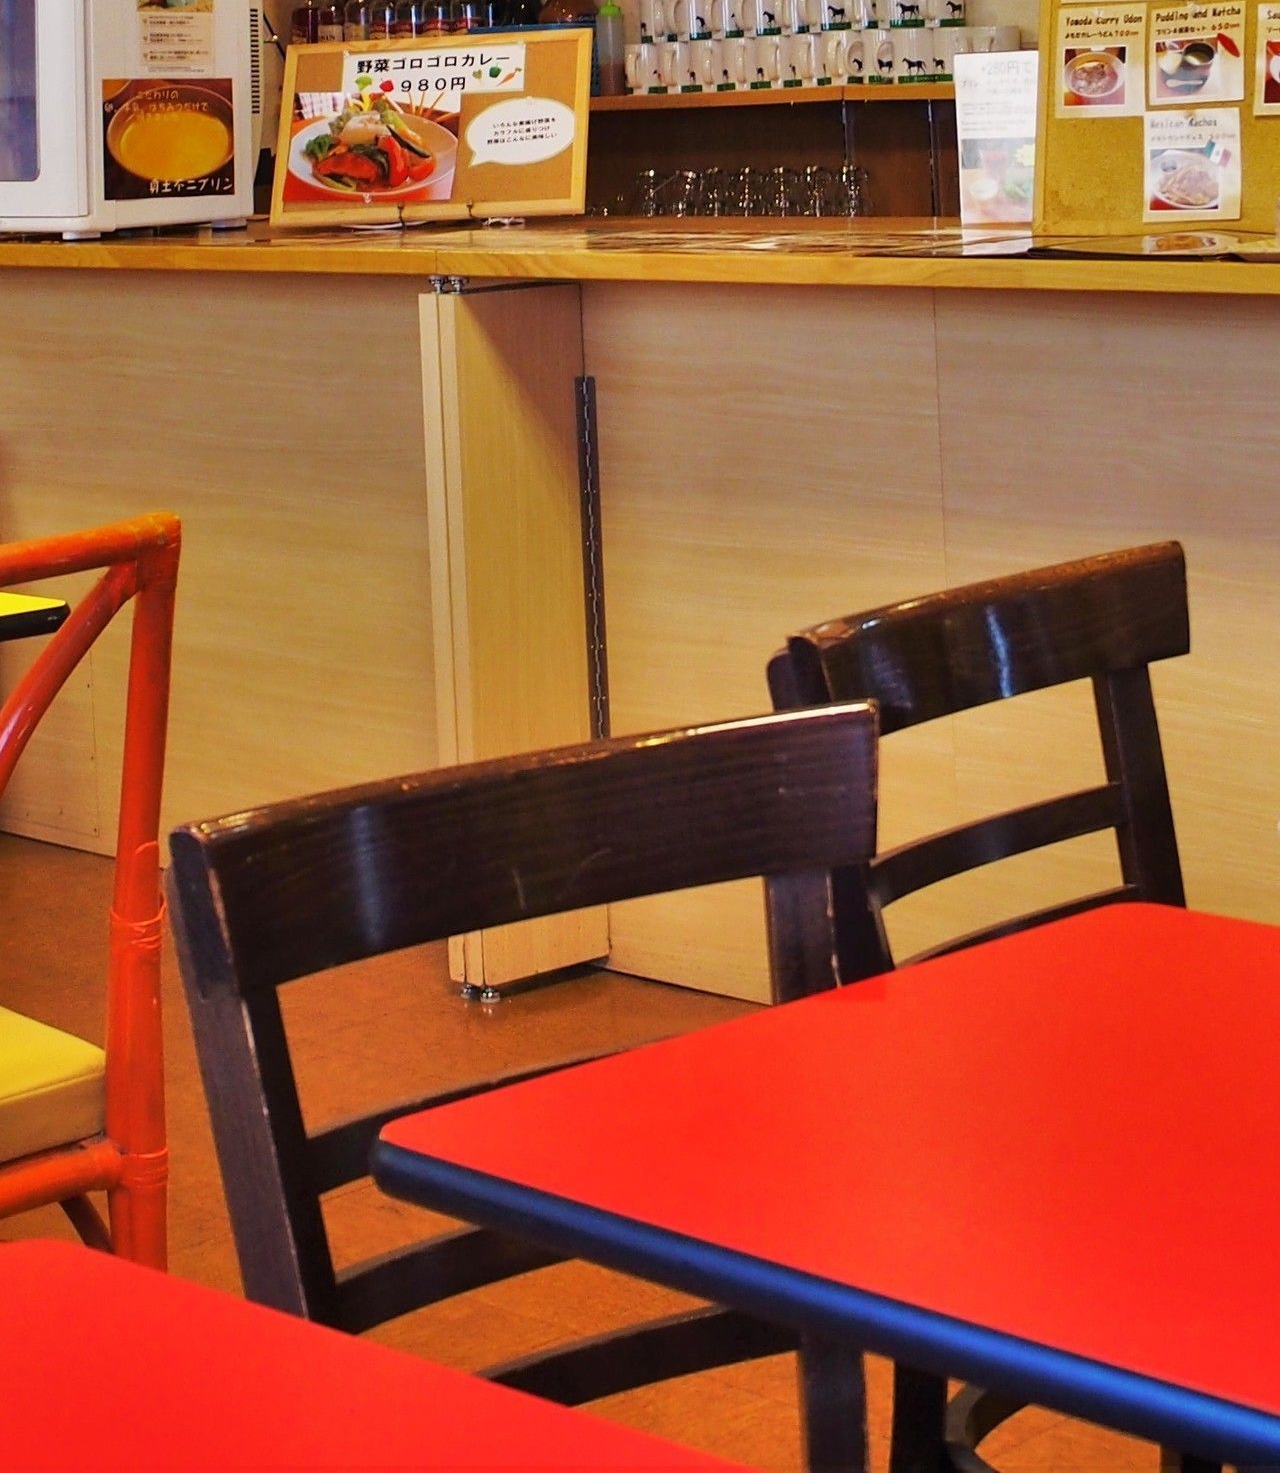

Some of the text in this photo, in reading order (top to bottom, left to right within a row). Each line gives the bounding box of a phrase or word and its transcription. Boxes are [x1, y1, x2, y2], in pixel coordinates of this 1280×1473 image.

[1123, 13, 1143, 24] Udon
[357, 53, 510, 74] 野菜ゴロゴロカレー
[400, 76, 467, 92] 980円
